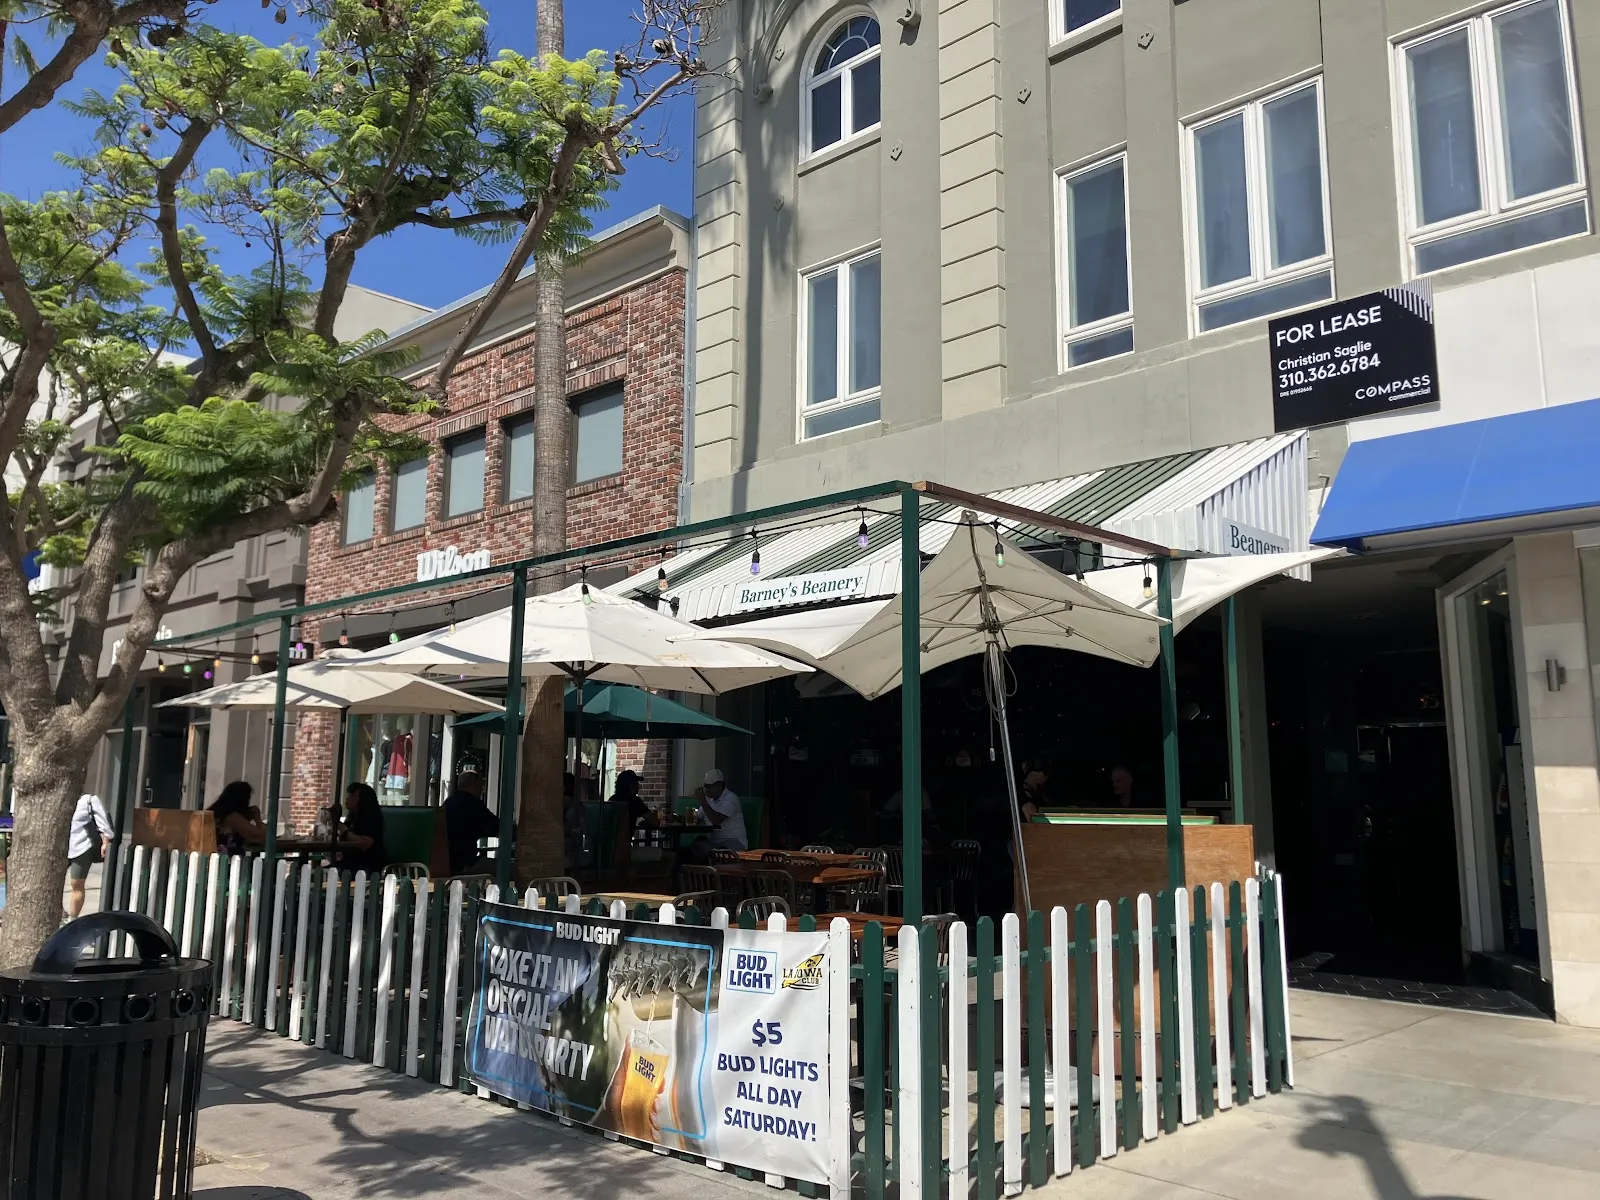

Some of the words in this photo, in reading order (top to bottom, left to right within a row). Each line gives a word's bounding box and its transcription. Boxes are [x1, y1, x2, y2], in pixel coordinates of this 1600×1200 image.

[1276, 324, 1314, 347] FOR
[1320, 305, 1382, 336] LEASE
[1278, 350, 1331, 371] Christian
[1334, 340, 1372, 359] Saglie
[1279, 353, 1381, 388] 310.362.6784
[1355, 375, 1431, 400] COMPASS
[1388, 386, 1431, 402] commercial
[416, 545, 491, 582] Wilson
[740, 582, 798, 604] Barney's
[801, 576, 863, 595] Beanery
[556, 921, 583, 941] BUD
[582, 925, 621, 945] LIGHT
[531, 954, 552, 989] IT
[552, 958, 579, 994] AN
[736, 954, 768, 972] BUD
[729, 970, 773, 989] LIGHT
[752, 1018, 783, 1048] $5
[634, 1062, 656, 1082] LIGHT
[638, 1056, 655, 1072] BUD
[717, 1053, 755, 1072] BUD
[760, 1056, 819, 1082] LIGHTS
[736, 1081, 764, 1104] ALL
[767, 1086, 803, 1110] DAY
[724, 1106, 816, 1142] SATURDAY!
